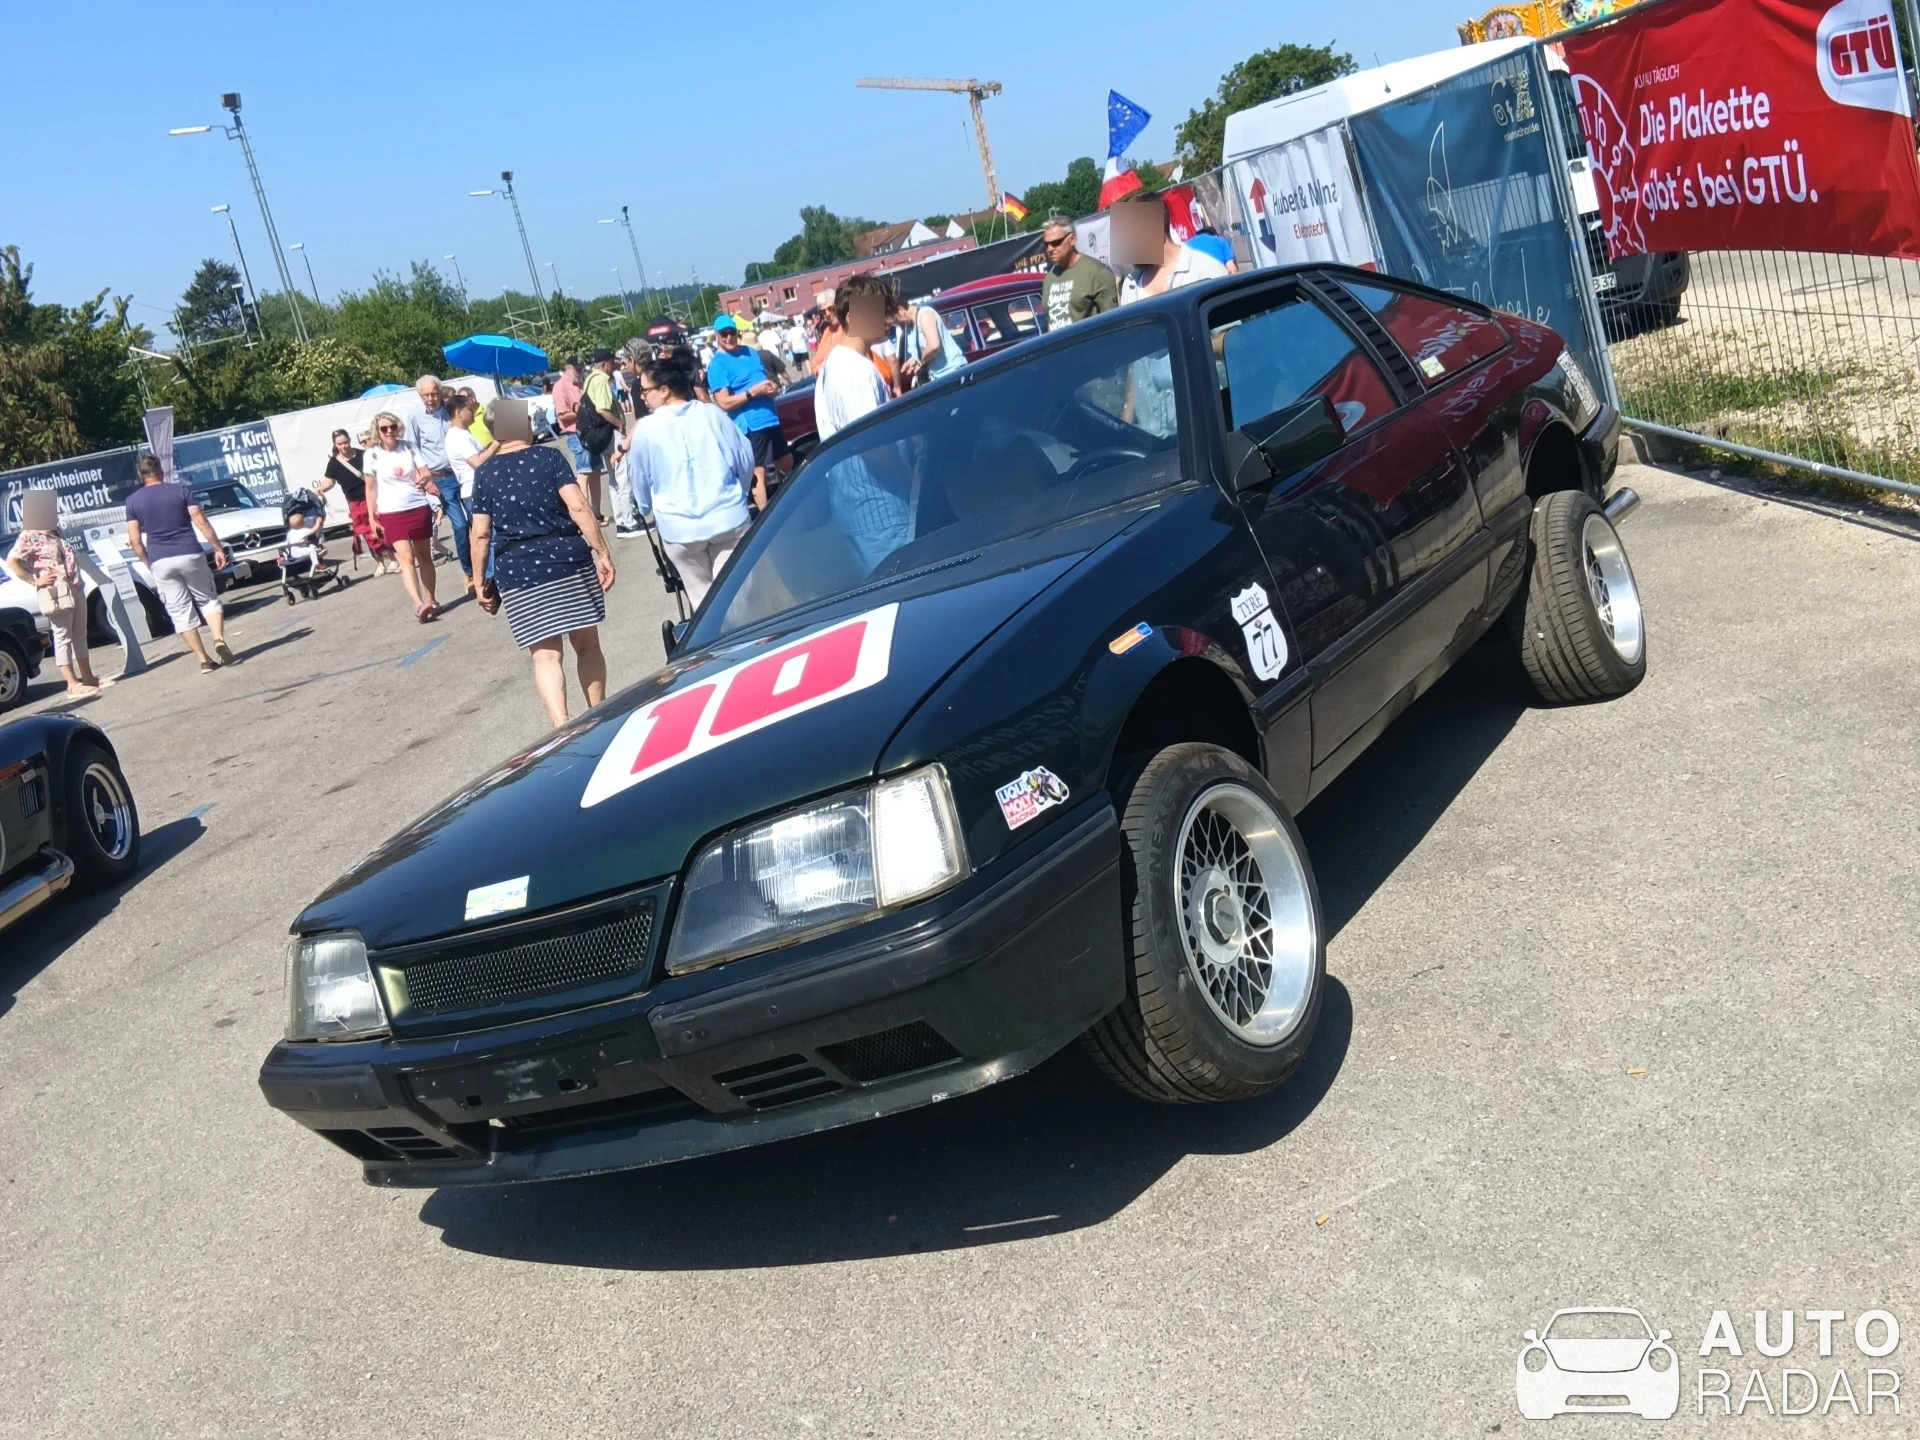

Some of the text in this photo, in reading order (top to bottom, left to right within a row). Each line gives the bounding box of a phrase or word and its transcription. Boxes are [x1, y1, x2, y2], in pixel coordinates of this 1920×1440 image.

[1830, 14, 1897, 76] GTÜ
[1639, 86, 1770, 147] Die Plakette
[1697, 158, 1742, 208] bei
[1743, 138, 1819, 204] GTÜ.
[1297, 185, 1309, 209] &
[219, 428, 273, 453] 27. Kirc
[224, 445, 280, 475] Musik
[28, 467, 103, 491] Kirchheimer
[11, 483, 112, 522] Mknacht
[1237, 592, 1264, 619] TYRE
[1253, 623, 1279, 668] 77
[630, 620, 868, 775] 10
[999, 779, 1027, 804] LIQU
[1004, 790, 1034, 819] MOLY
[1008, 807, 1038, 827] RACING
